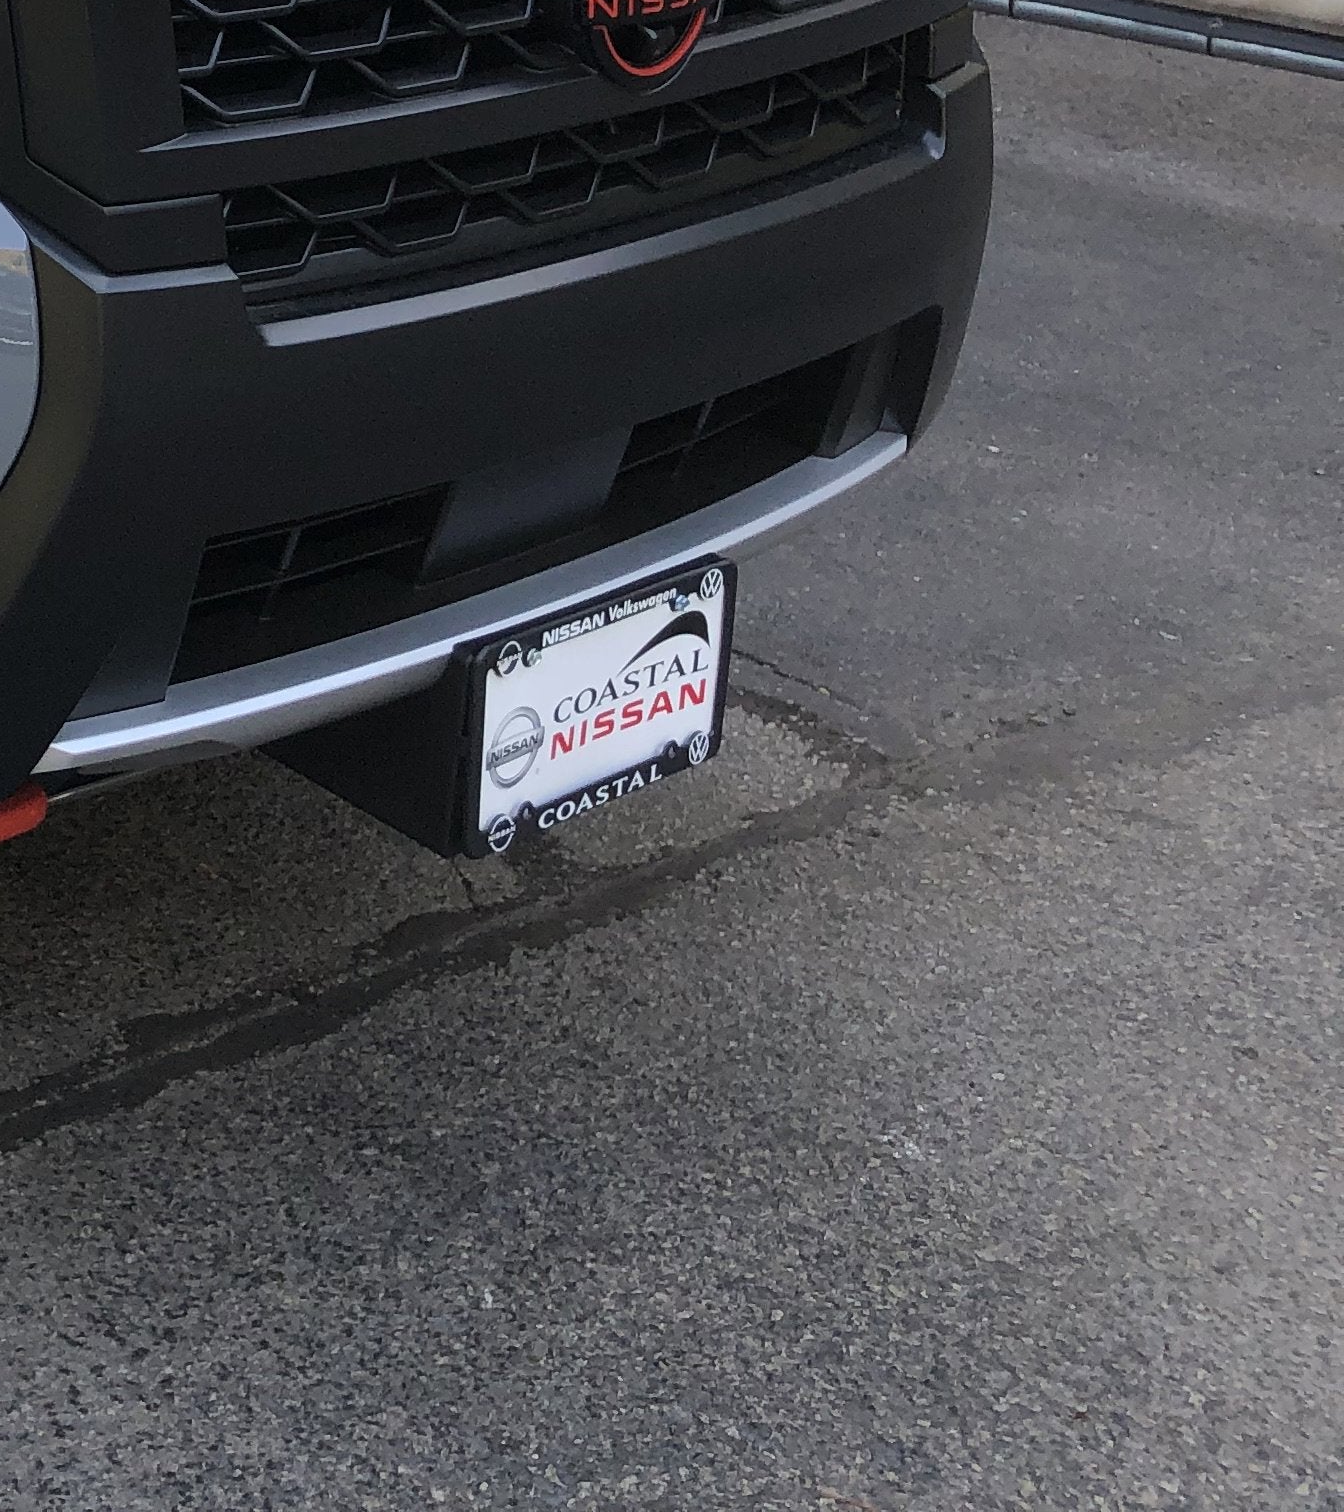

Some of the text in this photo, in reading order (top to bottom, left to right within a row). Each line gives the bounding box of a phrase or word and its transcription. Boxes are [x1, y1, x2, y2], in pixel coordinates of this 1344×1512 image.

[542, 588, 676, 647] NISSAN Volkswagen
[550, 678, 706, 760] NISSAN
[553, 648, 709, 724] COASTAL
[490, 733, 540, 763] NISSAN
[538, 763, 662, 829] COASTAL
